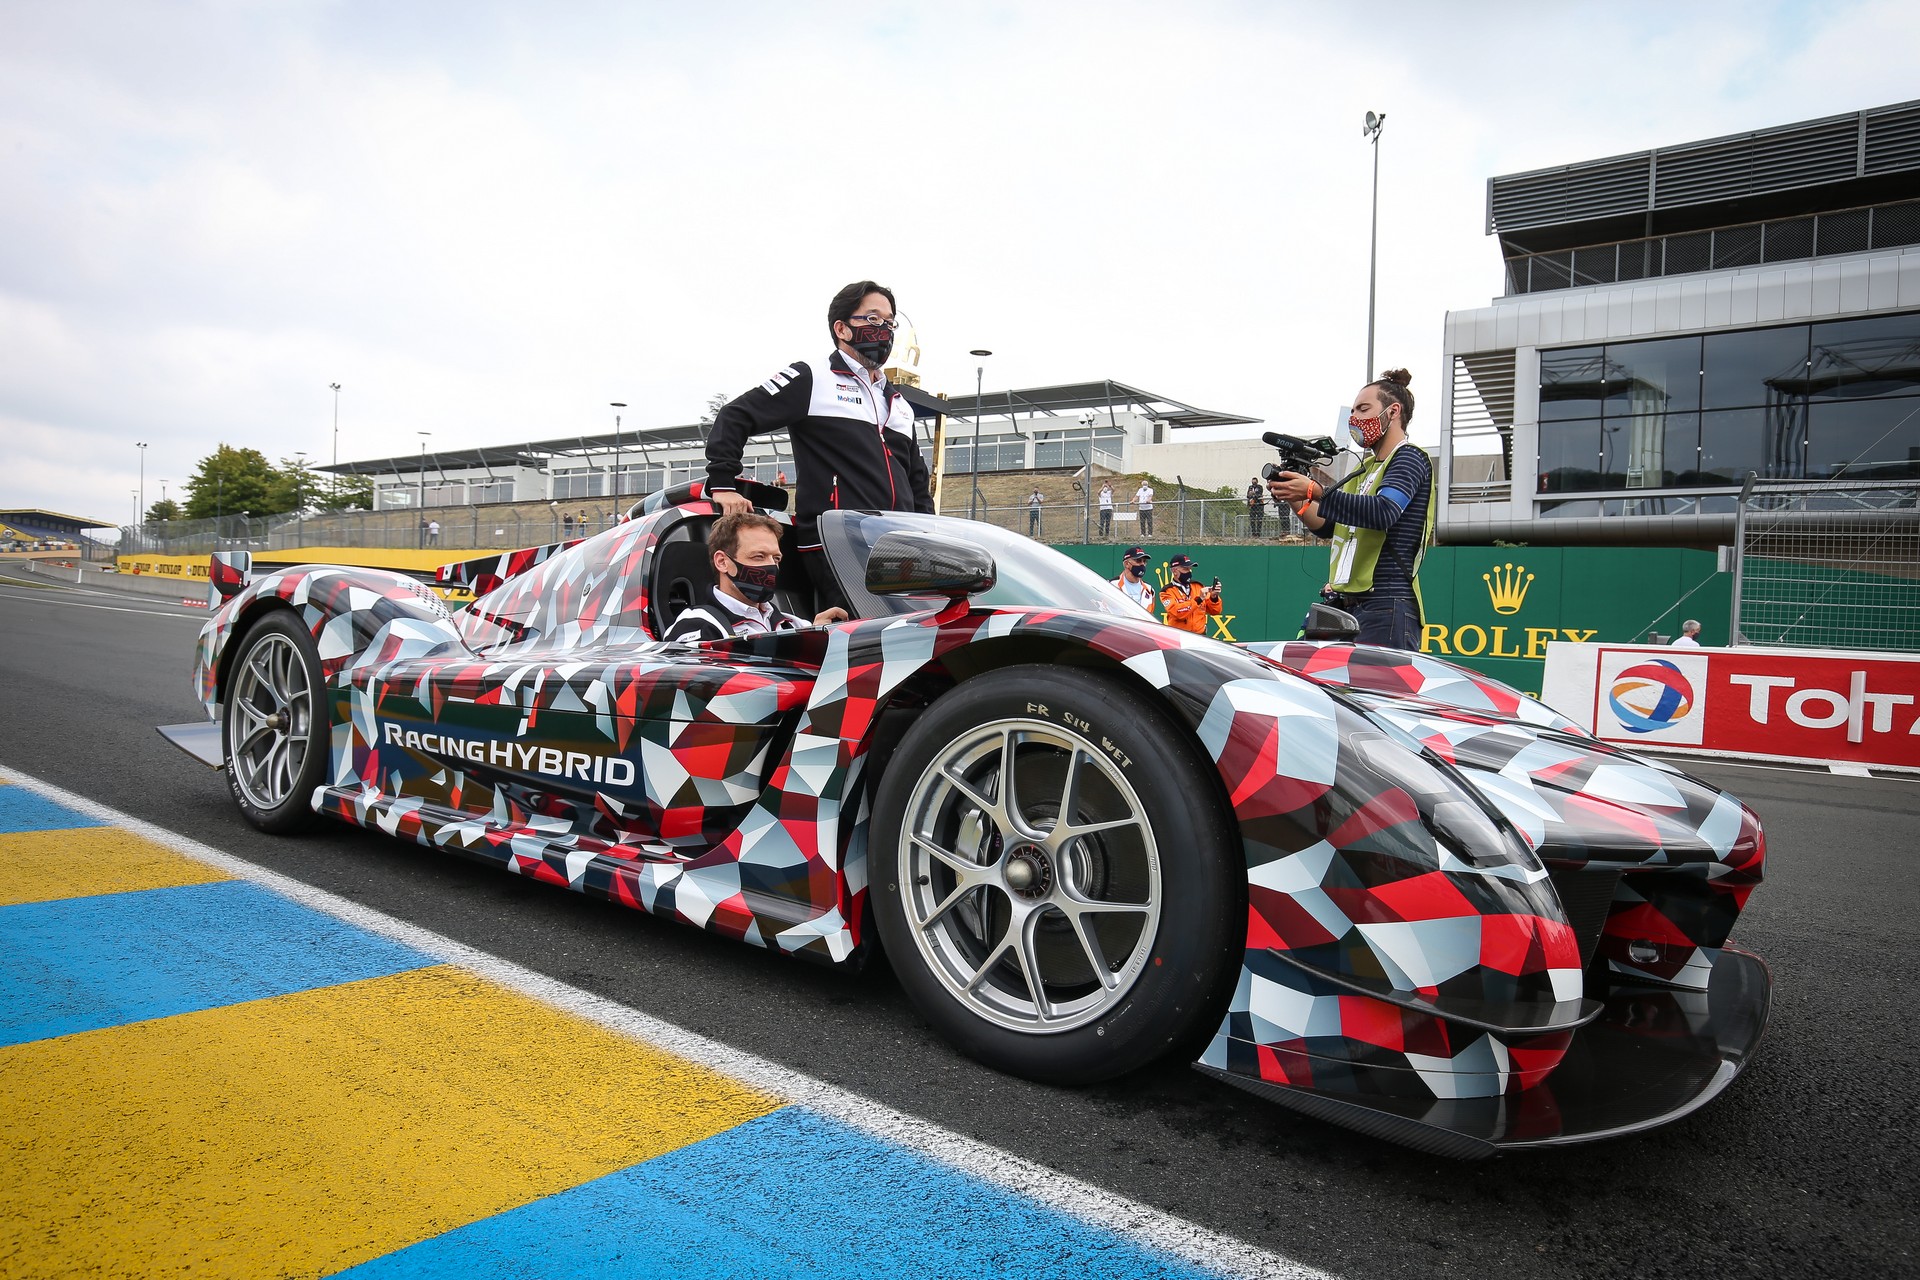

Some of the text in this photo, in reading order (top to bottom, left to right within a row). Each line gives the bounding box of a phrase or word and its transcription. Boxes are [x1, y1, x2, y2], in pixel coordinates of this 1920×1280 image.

[837, 395, 856, 403] Mobil
[159, 563, 182, 575] DUNLOP
[1729, 673, 1920, 736] TOT
[383, 721, 636, 787] RACING HYBRID
[1026, 702, 1133, 768] FR S14 WET
[225, 755, 235, 776] WET
